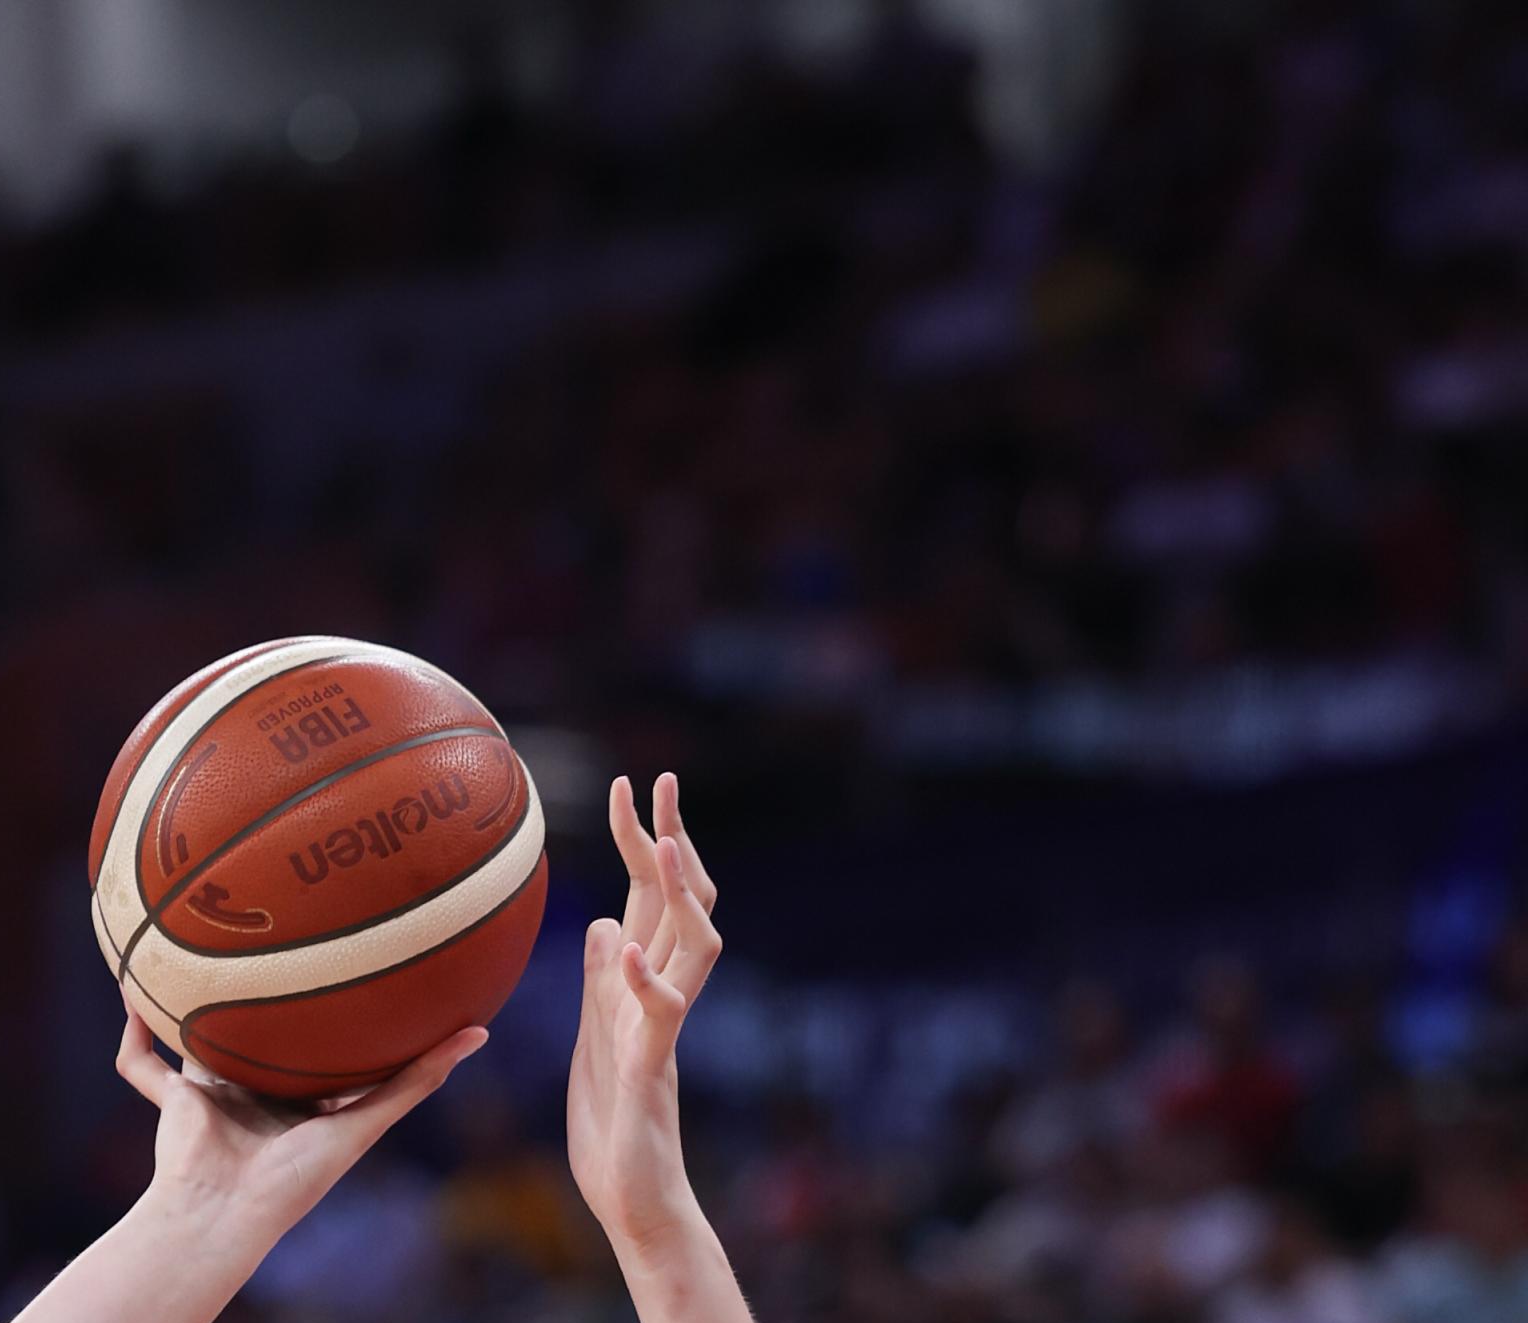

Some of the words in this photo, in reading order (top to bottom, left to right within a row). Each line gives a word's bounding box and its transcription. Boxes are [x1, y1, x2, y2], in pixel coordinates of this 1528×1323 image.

[257, 683, 345, 732] APPROVED
[268, 697, 371, 765] FIBA
[288, 772, 470, 885] molten
